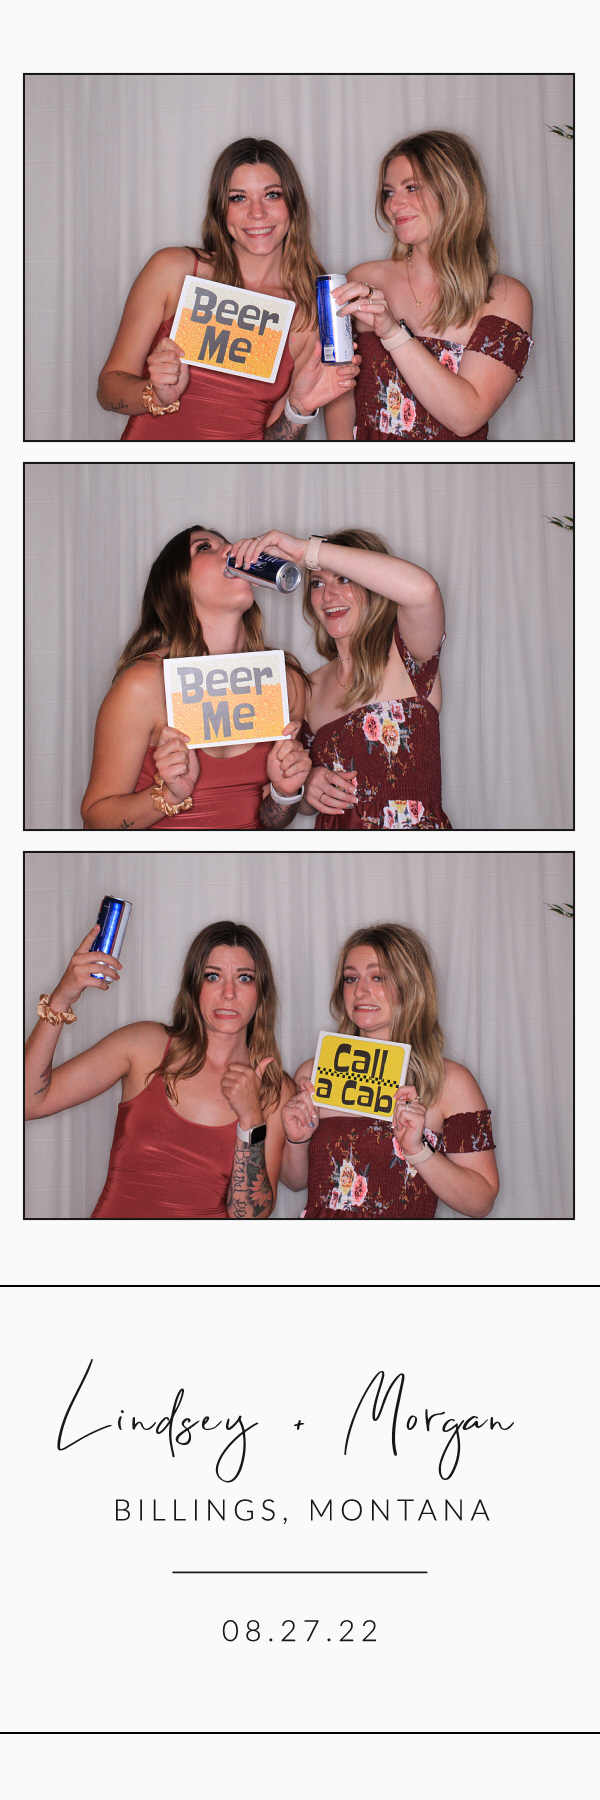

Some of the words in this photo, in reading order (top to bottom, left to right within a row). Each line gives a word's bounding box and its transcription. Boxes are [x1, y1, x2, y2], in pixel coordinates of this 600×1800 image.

[190, 286, 279, 336] Beer
[198, 326, 252, 364] Me
[177, 667, 273, 704] Beer
[202, 701, 256, 741] Me
[334, 1043, 389, 1080] Call
[316, 1078, 333, 1099] a
